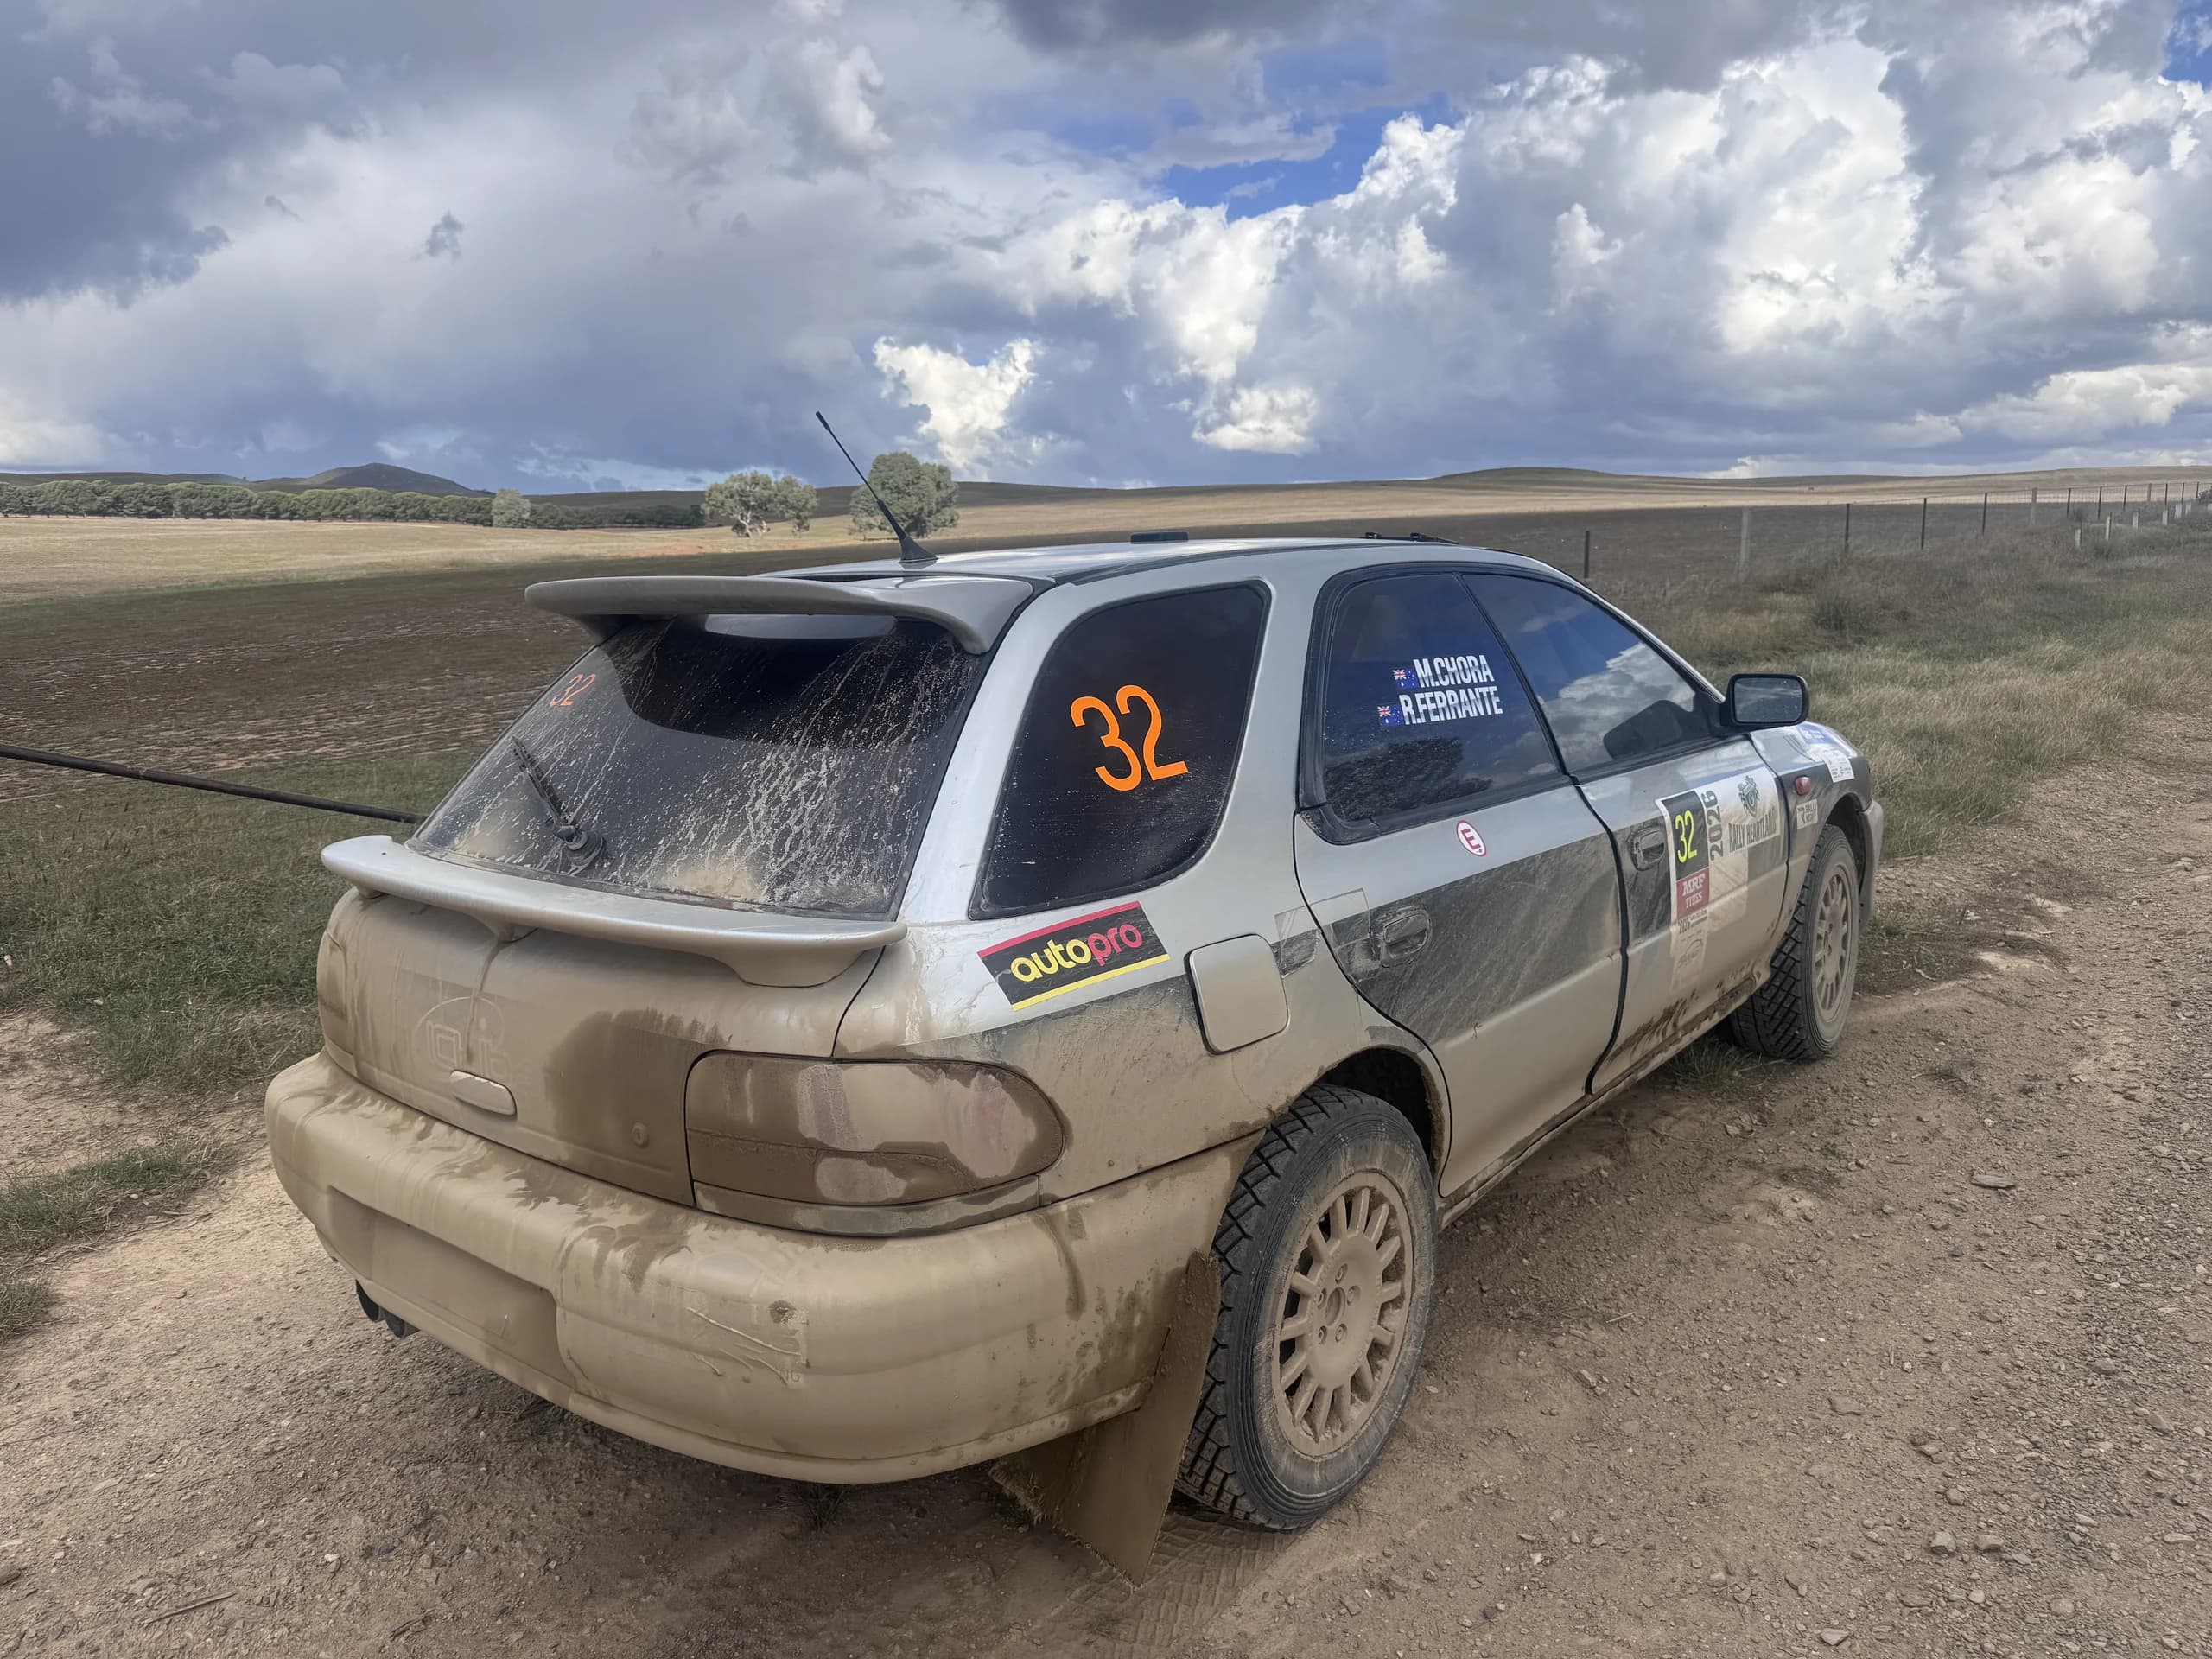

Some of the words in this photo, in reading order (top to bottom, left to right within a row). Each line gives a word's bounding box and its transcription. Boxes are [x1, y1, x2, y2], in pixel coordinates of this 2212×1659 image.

[1413, 654, 1495, 688] M.CHORA
[1399, 686, 1503, 725] R.FERRANTE
[1070, 684, 1188, 791] 32
[1675, 810, 1698, 863] 32
[1700, 790, 1723, 861] 2026
[1681, 873, 1705, 896] MRF
[1009, 922, 1143, 982] autopro
